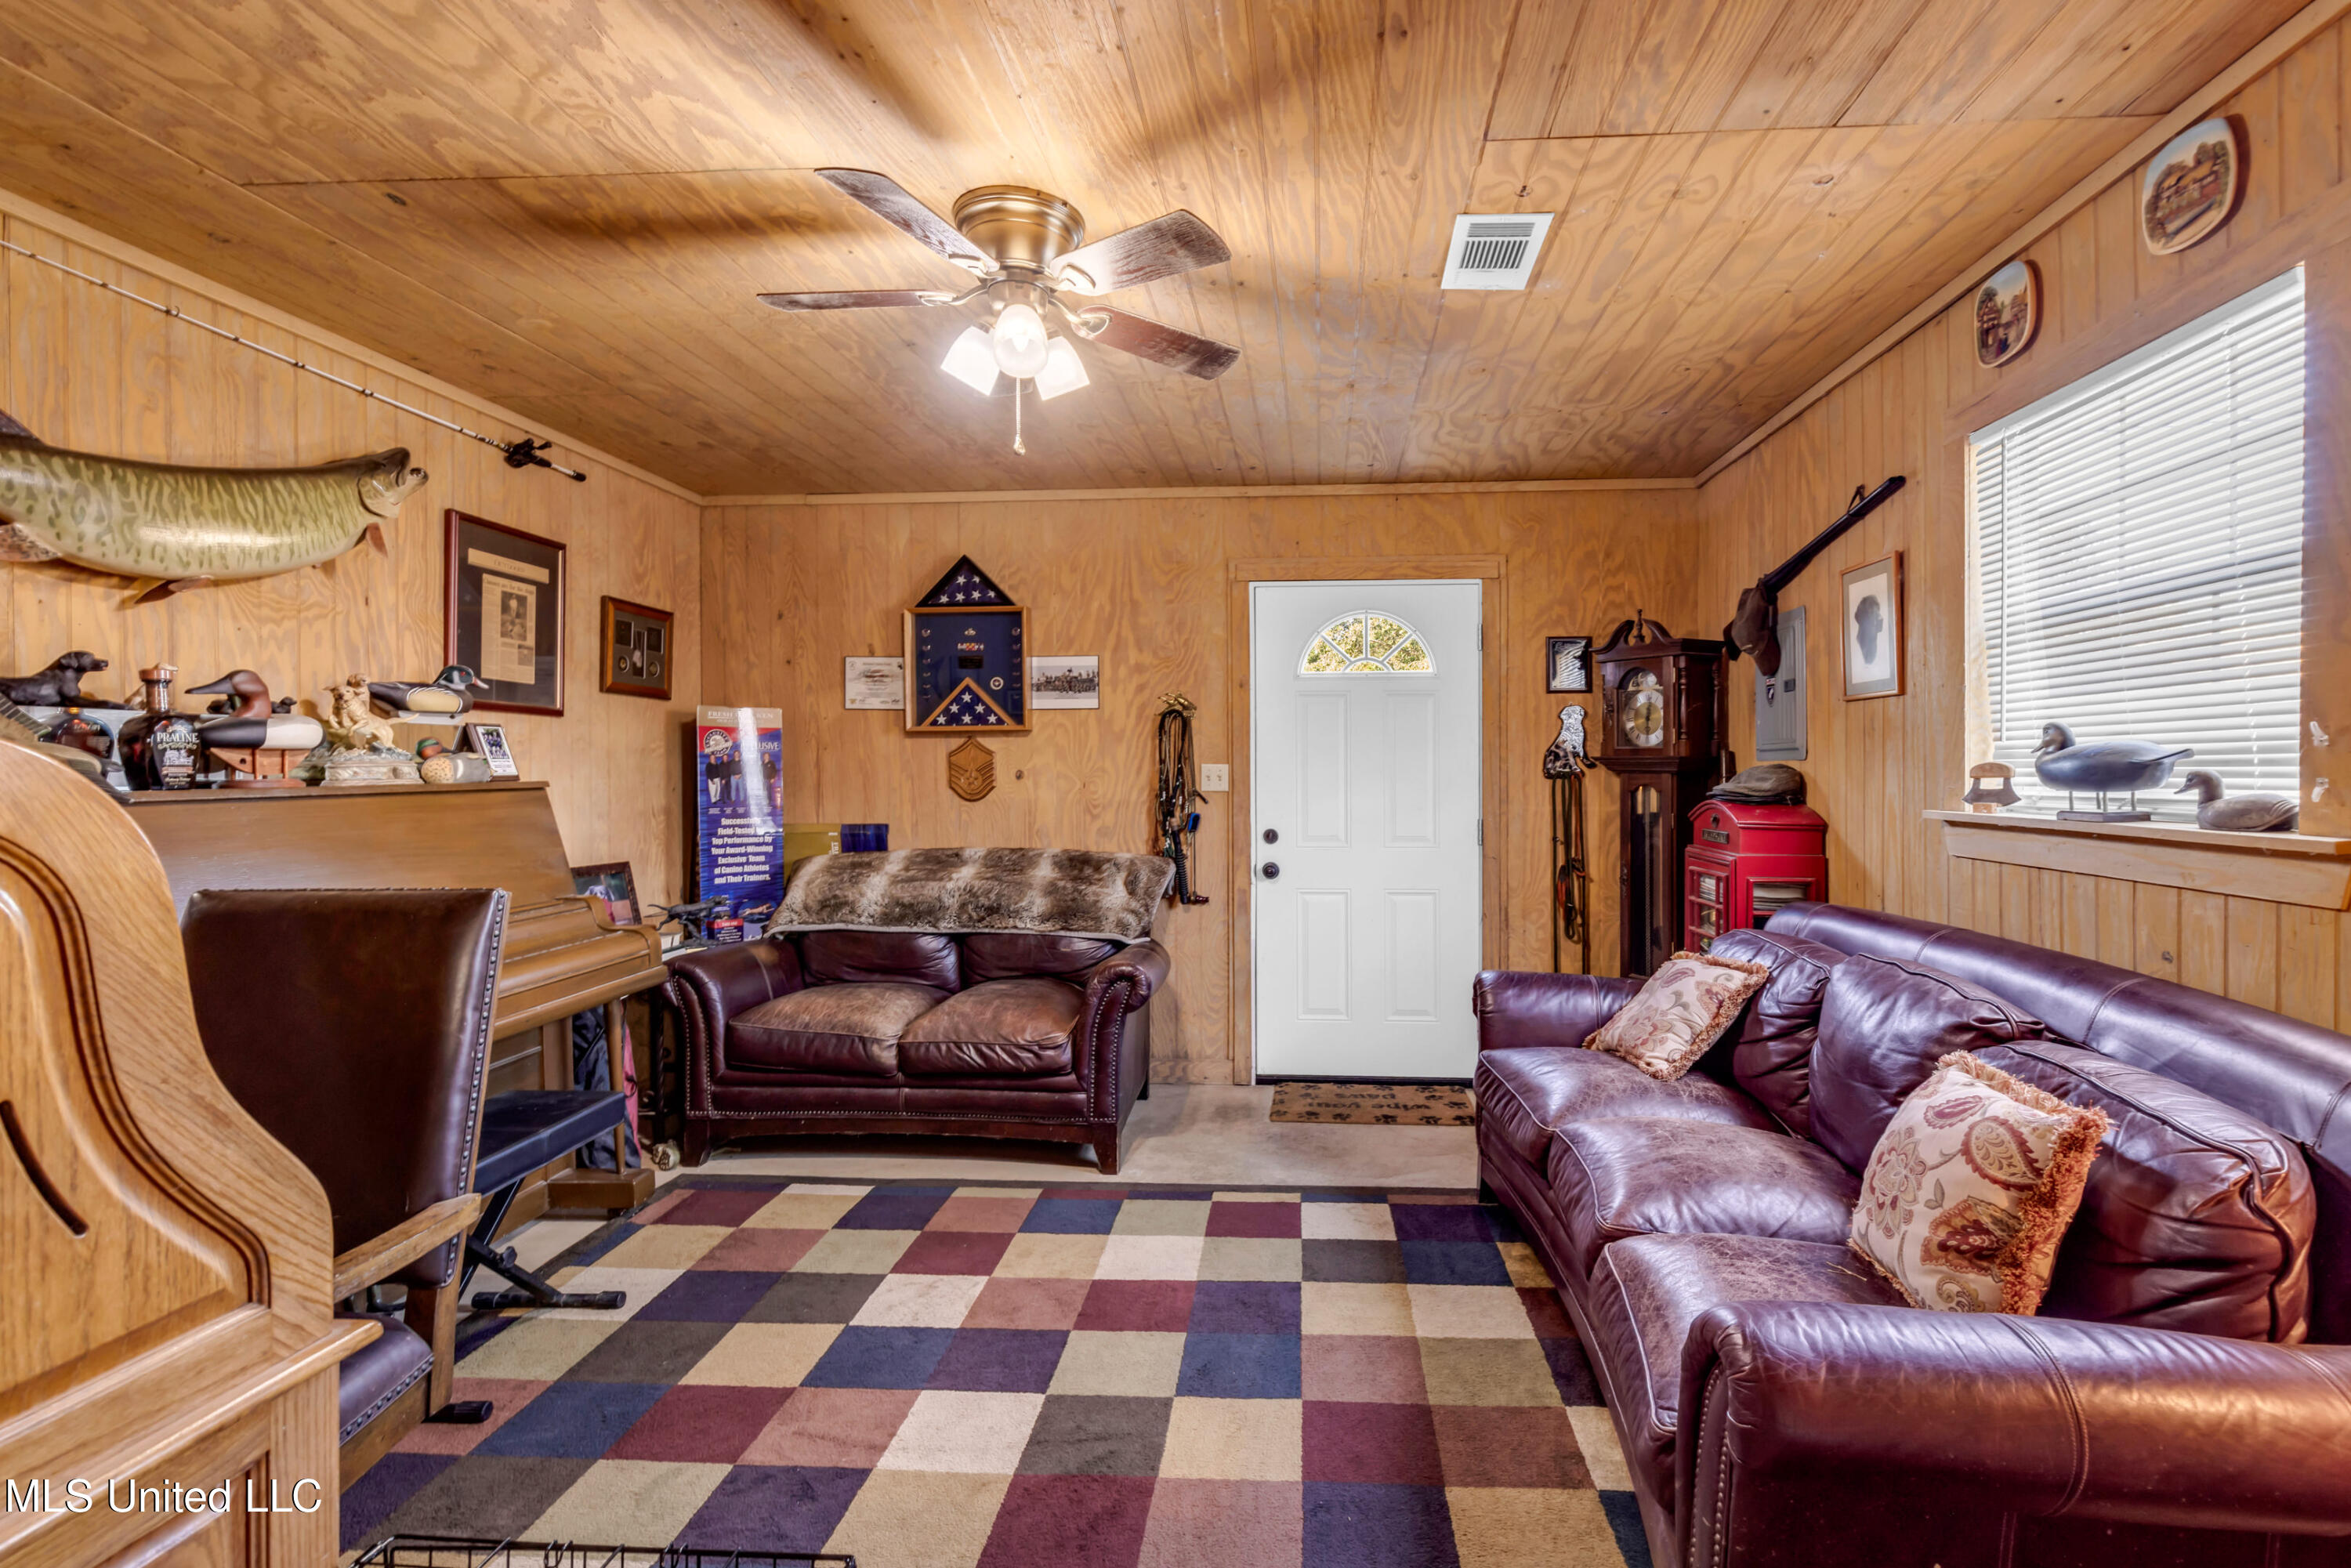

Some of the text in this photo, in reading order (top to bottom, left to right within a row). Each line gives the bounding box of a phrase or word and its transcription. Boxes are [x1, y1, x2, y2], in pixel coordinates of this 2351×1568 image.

[157, 732, 200, 743] PRALINE
[726, 845, 773, 853] Award-Winning
[718, 856, 747, 864] Exclusive
